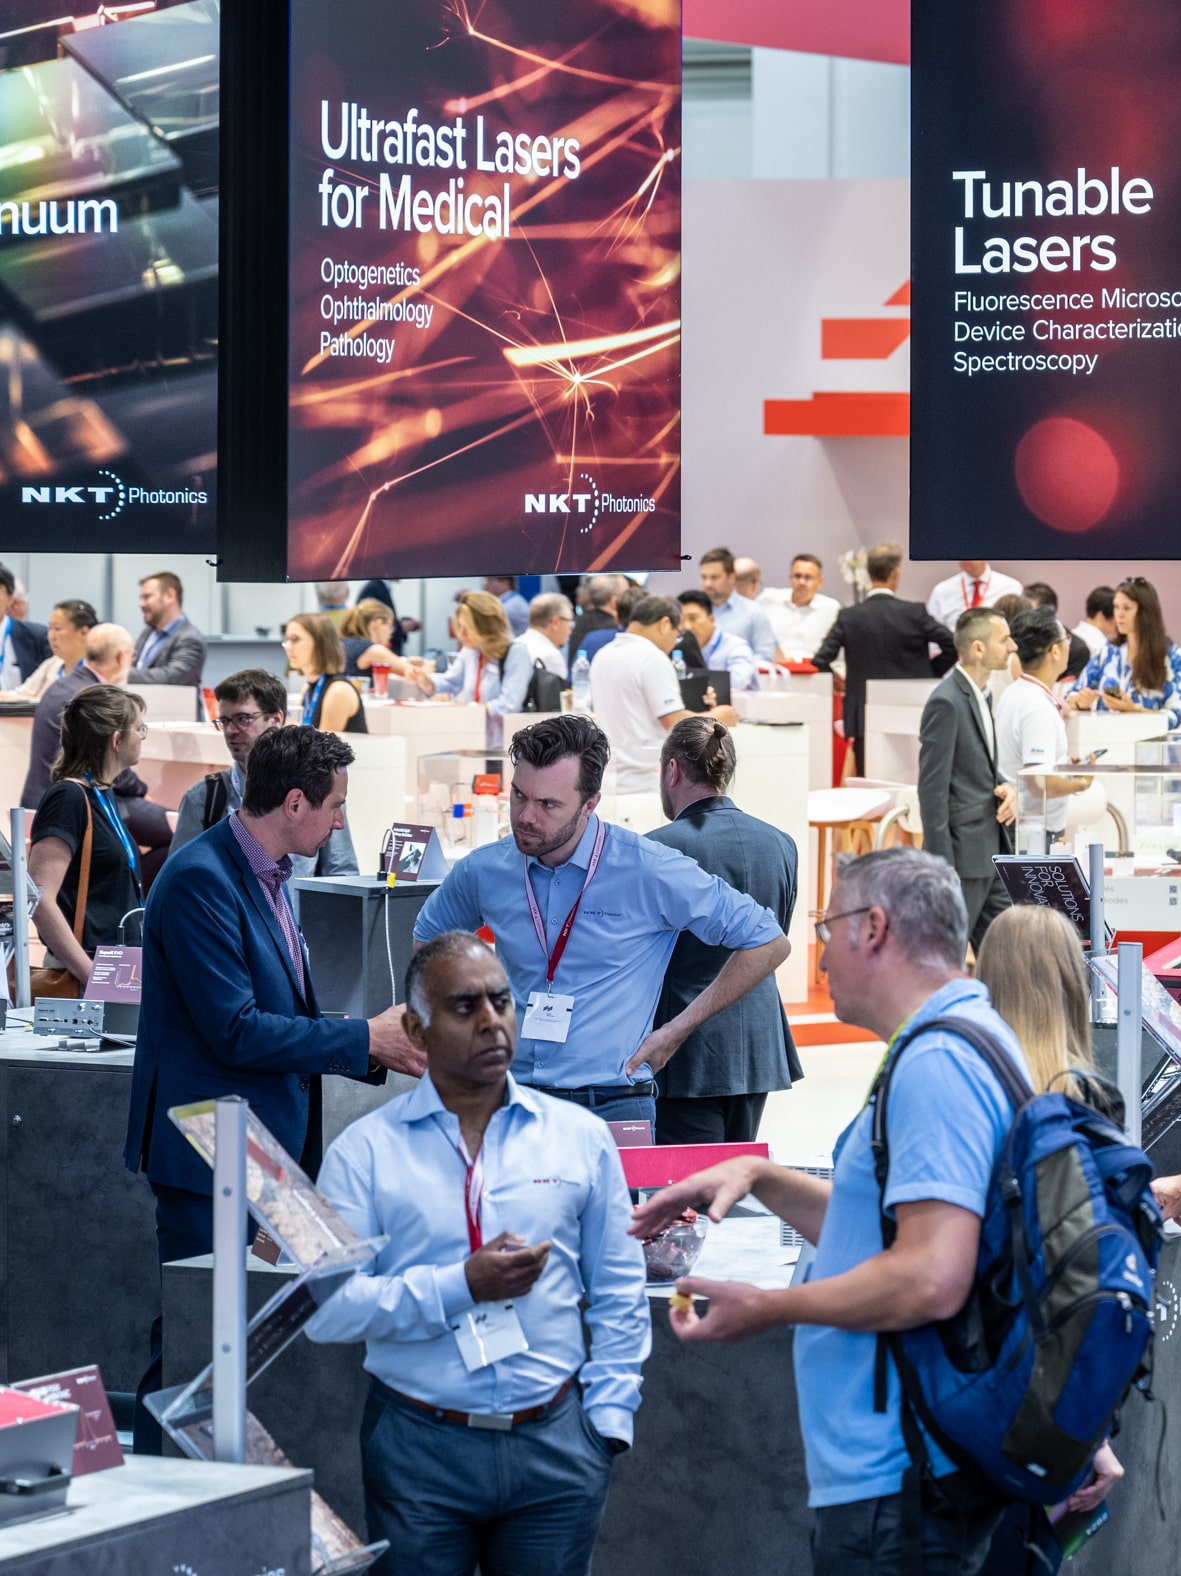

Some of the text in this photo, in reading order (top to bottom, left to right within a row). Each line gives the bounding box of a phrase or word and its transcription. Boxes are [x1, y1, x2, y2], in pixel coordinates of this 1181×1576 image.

[321, 100, 581, 180] Ultrafast Lasers
[319, 168, 510, 238] for Medical
[952, 166, 1154, 218] Tunable
[0, 199, 118, 235] nuum
[955, 226, 1117, 274] Lasers
[320, 257, 420, 290] Optogenetics
[320, 294, 434, 329] Ophthalmology
[954, 291, 1094, 312] Fluorescence
[320, 331, 395, 364] Pathology
[954, 321, 1025, 342] Device
[953, 351, 1098, 376] Spectroscopy
[22, 487, 208, 504] NKT Photonics
[524, 493, 656, 513] NKT Photonics
[1035, 866, 1055, 888] FOR
[1049, 865, 1084, 922] SOLUTIONS
